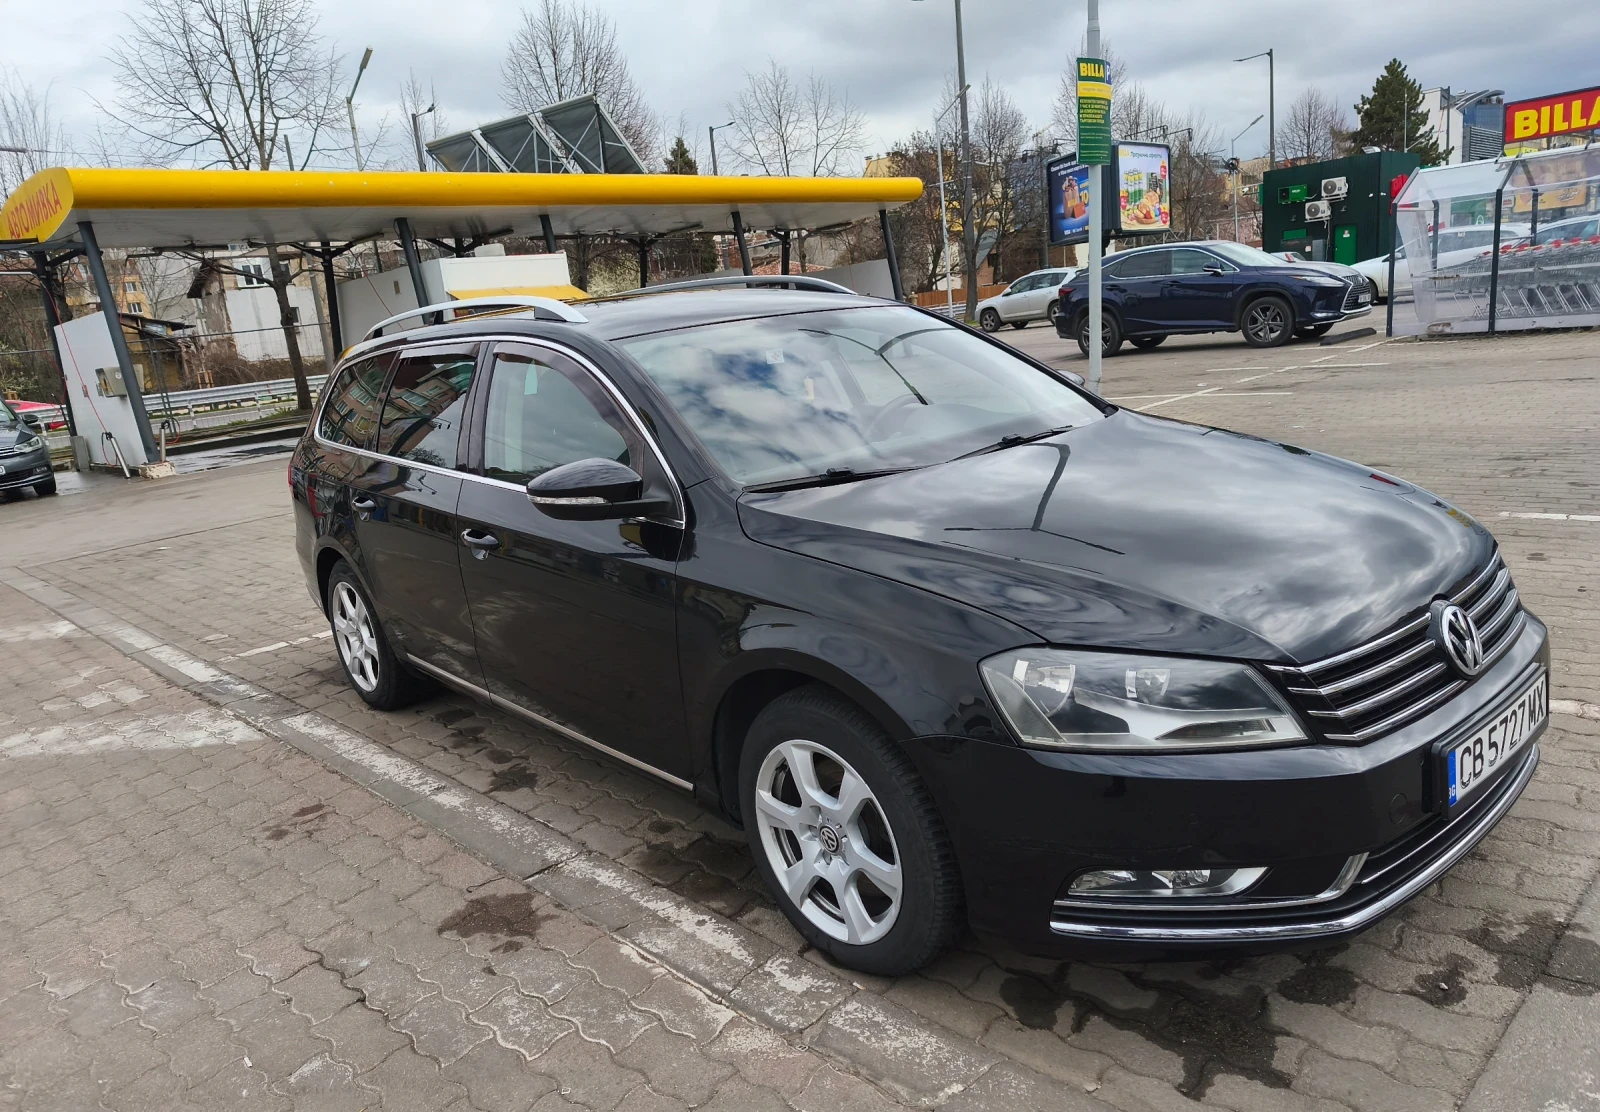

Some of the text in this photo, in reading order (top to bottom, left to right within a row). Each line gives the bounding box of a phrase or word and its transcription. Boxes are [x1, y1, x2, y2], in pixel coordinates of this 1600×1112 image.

[1080, 63, 1104, 78] BILLA
[7, 178, 62, 240] АВТОМИВКА
[1460, 680, 1544, 789] CB 5727 MX
